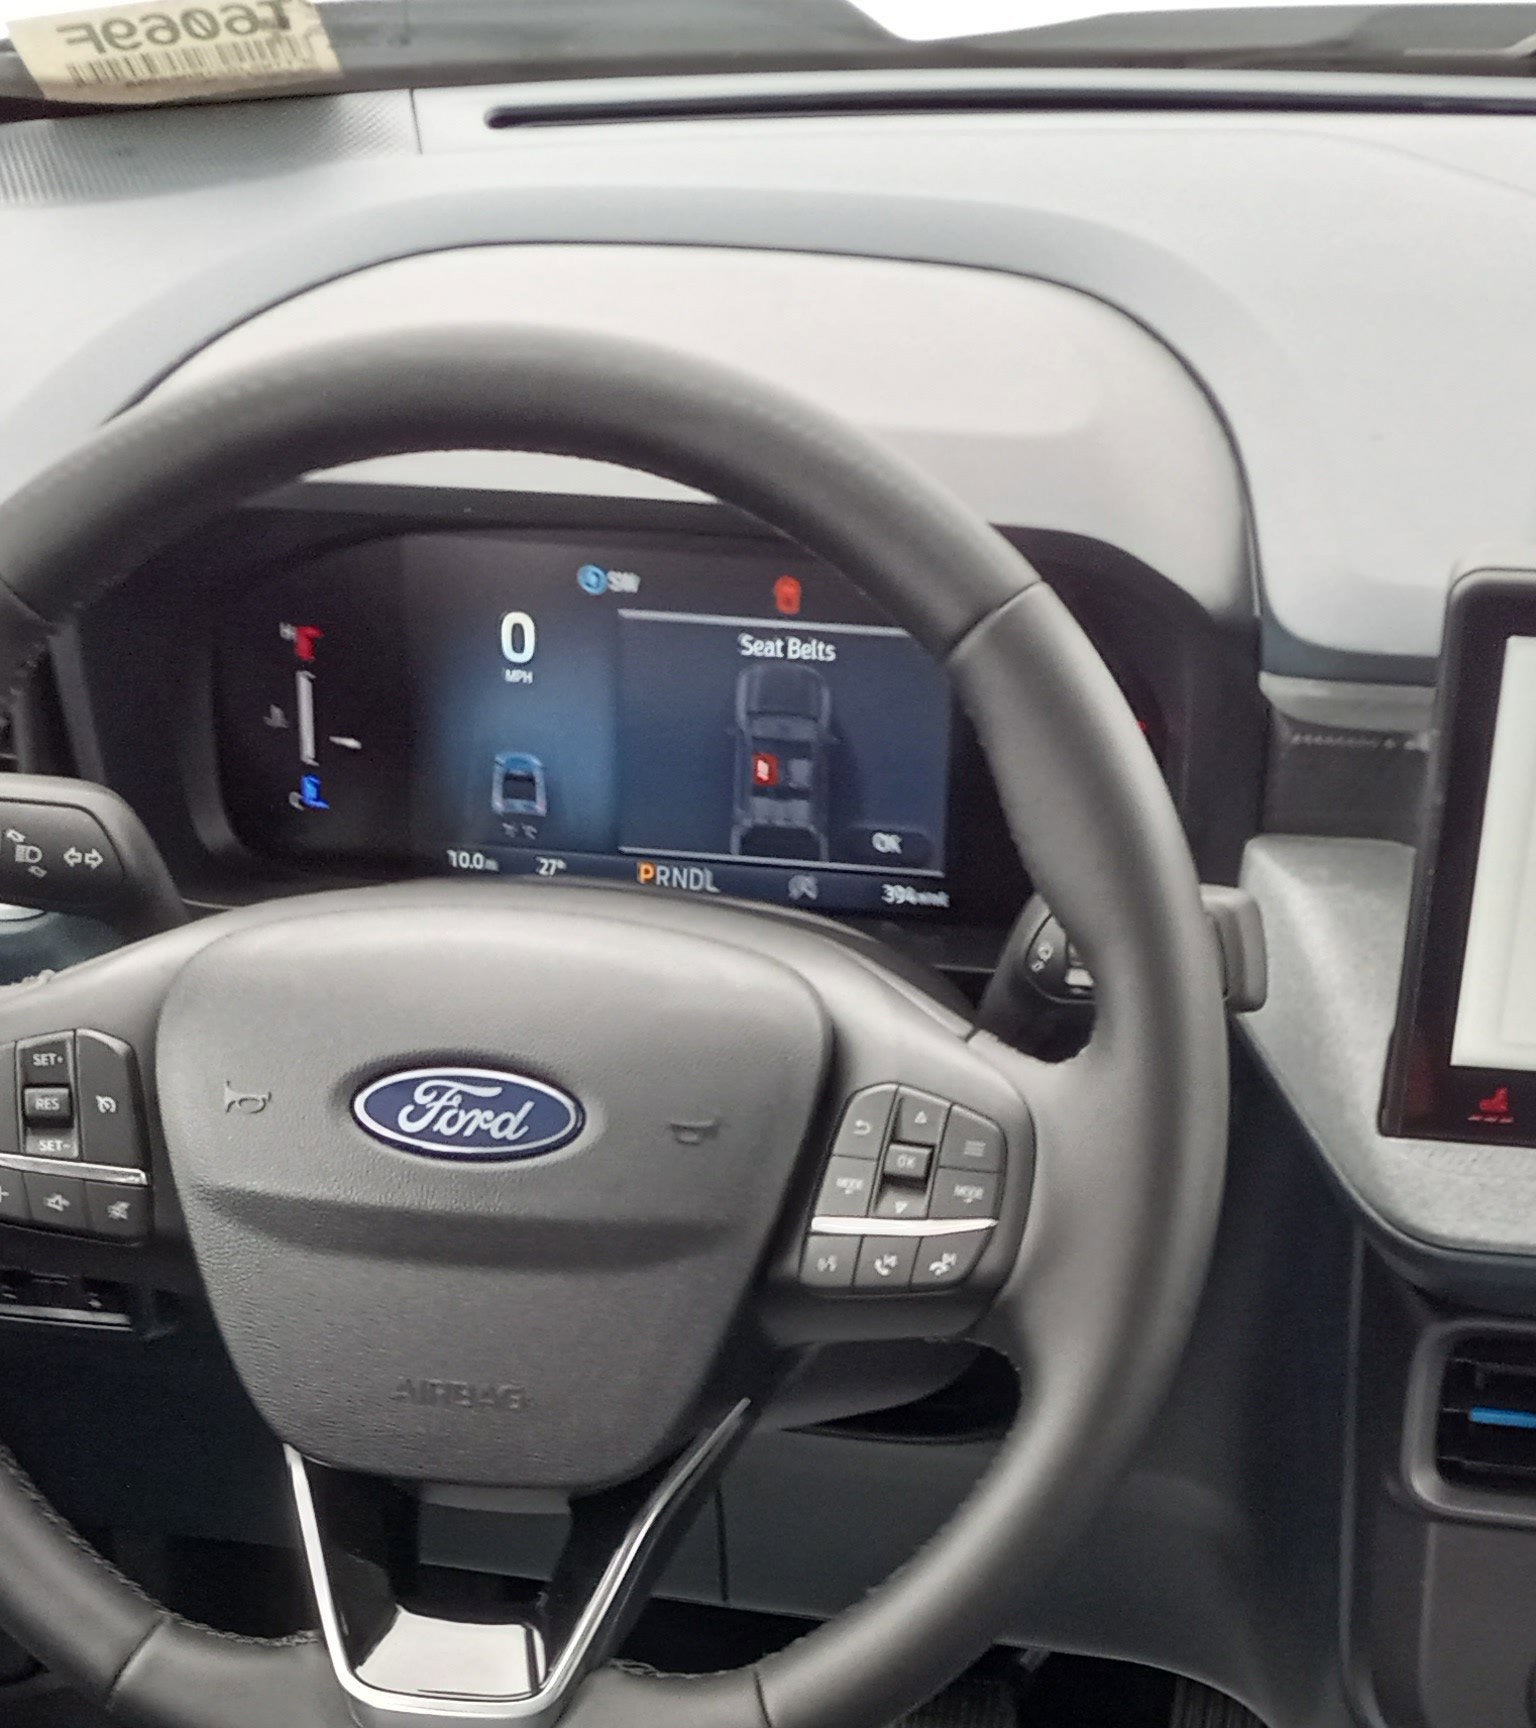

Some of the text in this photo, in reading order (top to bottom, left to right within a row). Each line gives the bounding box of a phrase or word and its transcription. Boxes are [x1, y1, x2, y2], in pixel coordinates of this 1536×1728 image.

[502, 611, 536, 664] 0
[739, 634, 836, 663] Seat Belts
[505, 670, 533, 685] MPH
[34, 1097, 61, 1112] RES
[397, 1079, 536, 1142] Ford
